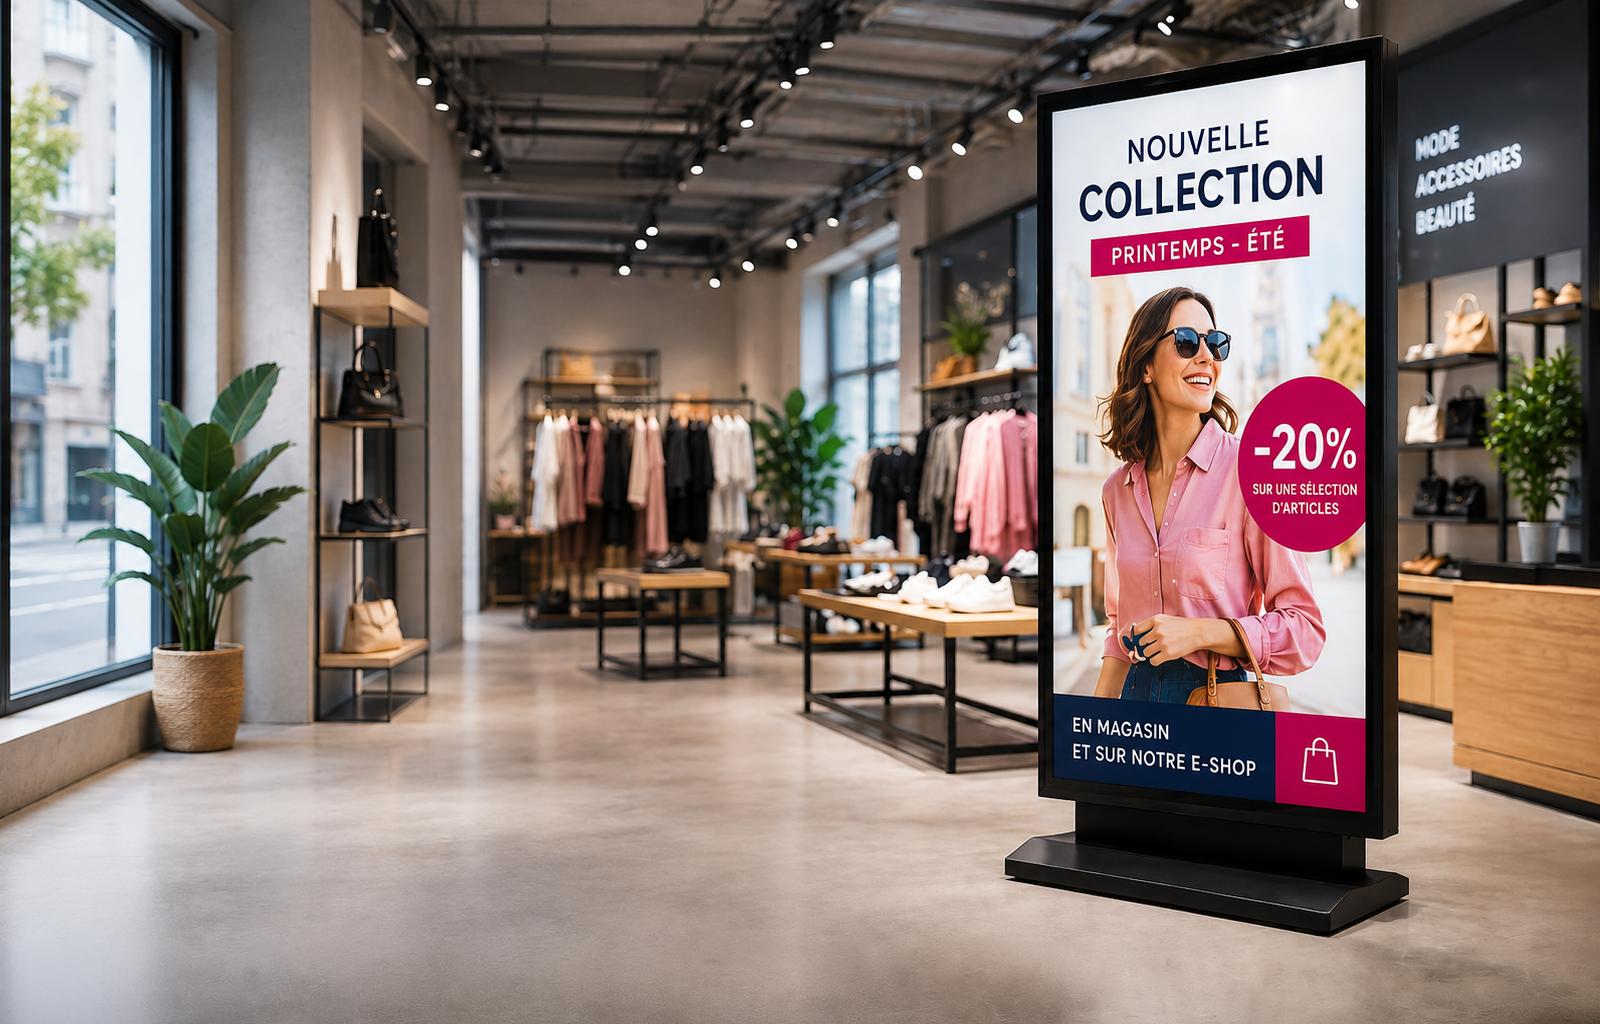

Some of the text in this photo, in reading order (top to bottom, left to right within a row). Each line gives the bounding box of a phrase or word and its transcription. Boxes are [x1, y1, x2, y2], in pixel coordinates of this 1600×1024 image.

[1128, 119, 1270, 164] NOUVELLE
[1415, 124, 1460, 162] MODE
[1079, 155, 1323, 222] COLLECTION
[1415, 143, 1522, 198] ACCESSOIRES
[1415, 191, 1475, 235] BEAUTÉ
[1111, 236, 1225, 265] PRINTEMPS
[1247, 225, 1285, 252] ÉTÉ
[1254, 422, 1357, 470] -20%
[1252, 481, 1358, 496] SUR UNE SÉLECTION
[1272, 501, 1340, 515] D'ARTICLES
[1072, 716, 1170, 740] EN MAGASIN
[1072, 743, 1257, 777] ET SUR NOTRE E-SHOP
